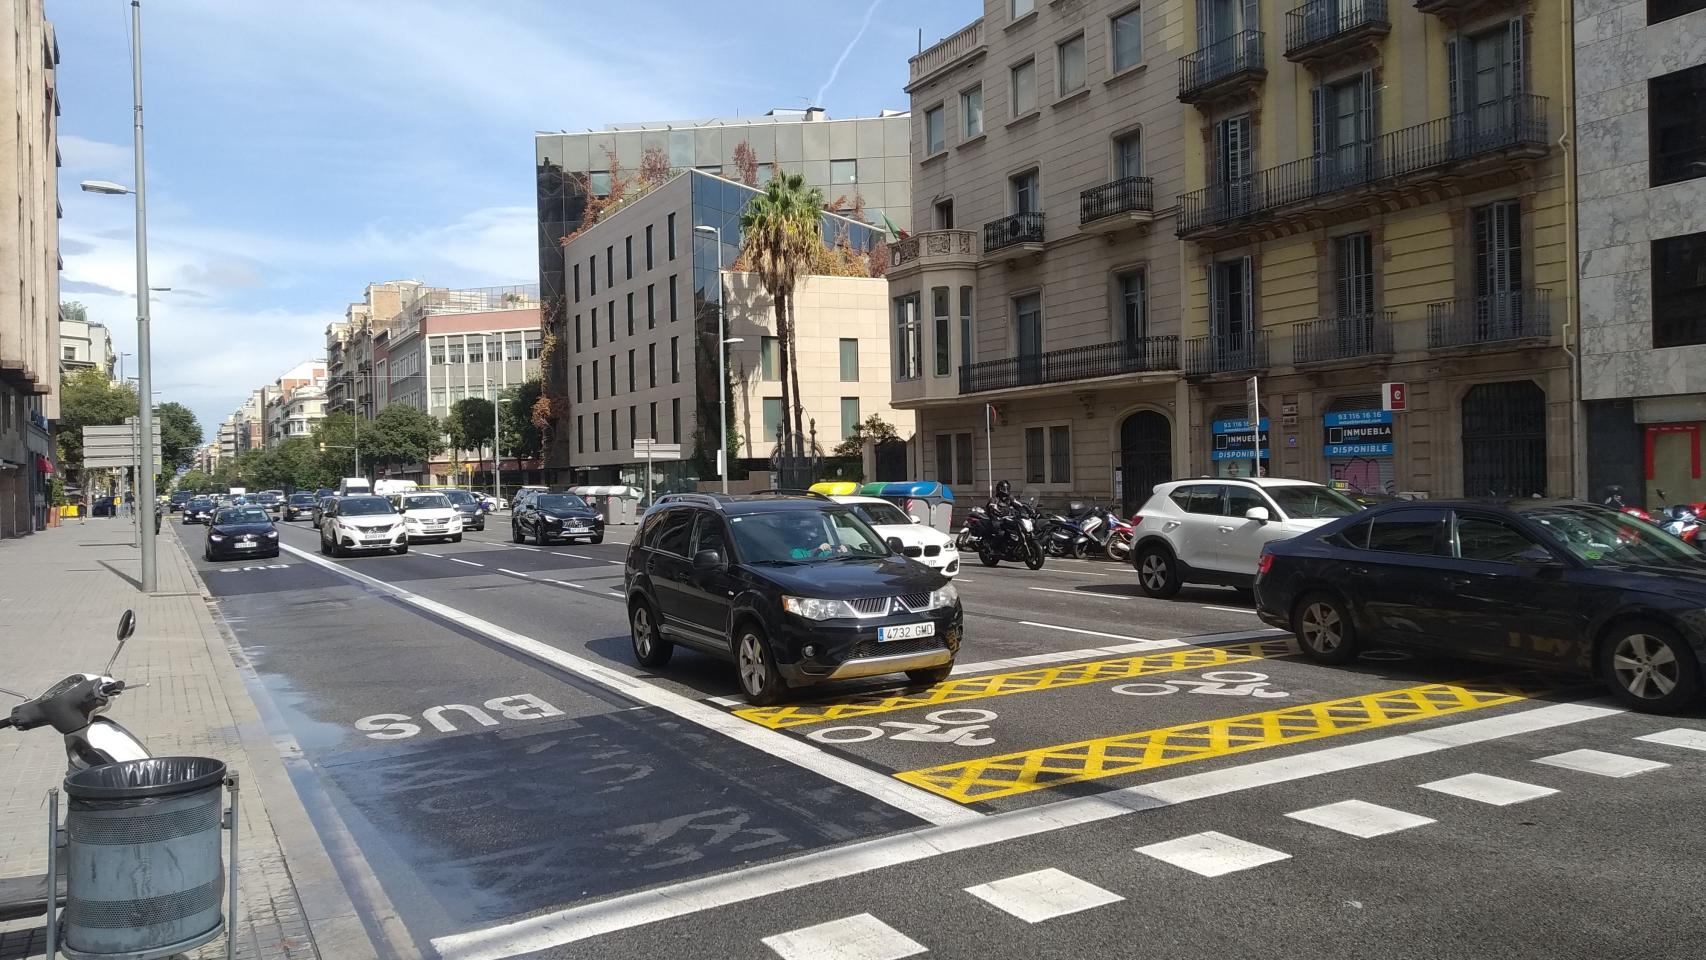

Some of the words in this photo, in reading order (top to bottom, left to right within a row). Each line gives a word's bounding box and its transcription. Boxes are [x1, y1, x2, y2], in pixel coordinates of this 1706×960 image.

[1343, 427, 1392, 437] INMUEBLA
[1332, 444, 1388, 454] DISPONIBLE
[886, 627, 911, 639] 4732
[915, 624, 933, 636] GMD
[354, 693, 567, 740] BUS
